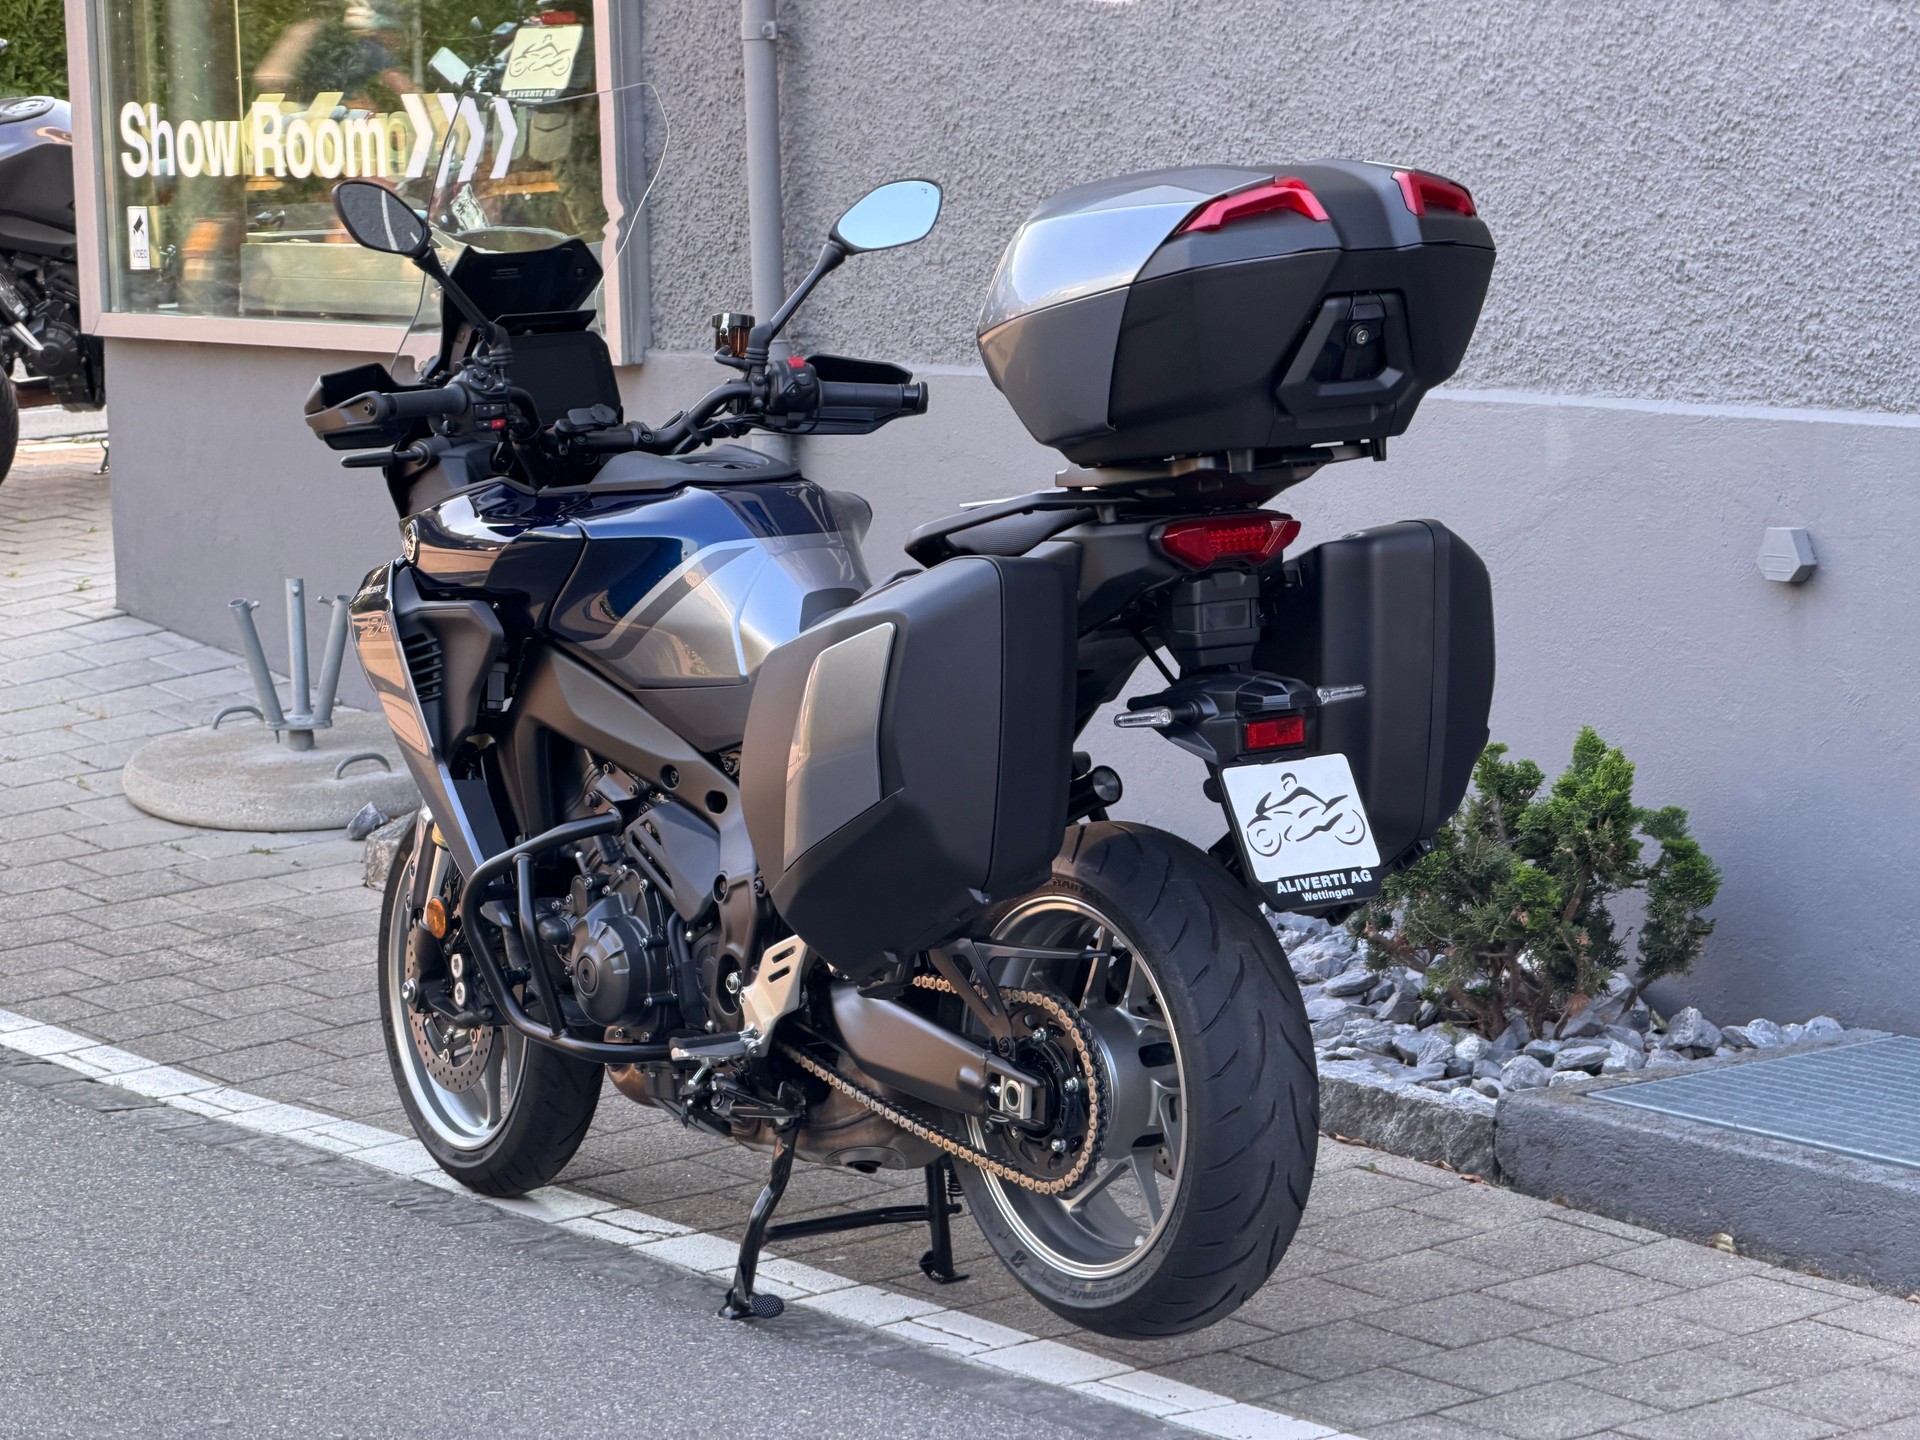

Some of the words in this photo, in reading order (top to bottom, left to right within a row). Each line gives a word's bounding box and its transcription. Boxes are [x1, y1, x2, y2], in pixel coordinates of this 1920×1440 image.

[506, 90, 543, 98] ALIVERTI
[120, 101, 241, 178] Show
[252, 101, 387, 179] Room
[1277, 872, 1347, 894] ALIVERTI
[1351, 869, 1373, 884] AG
[1302, 887, 1354, 902] Wettingen
